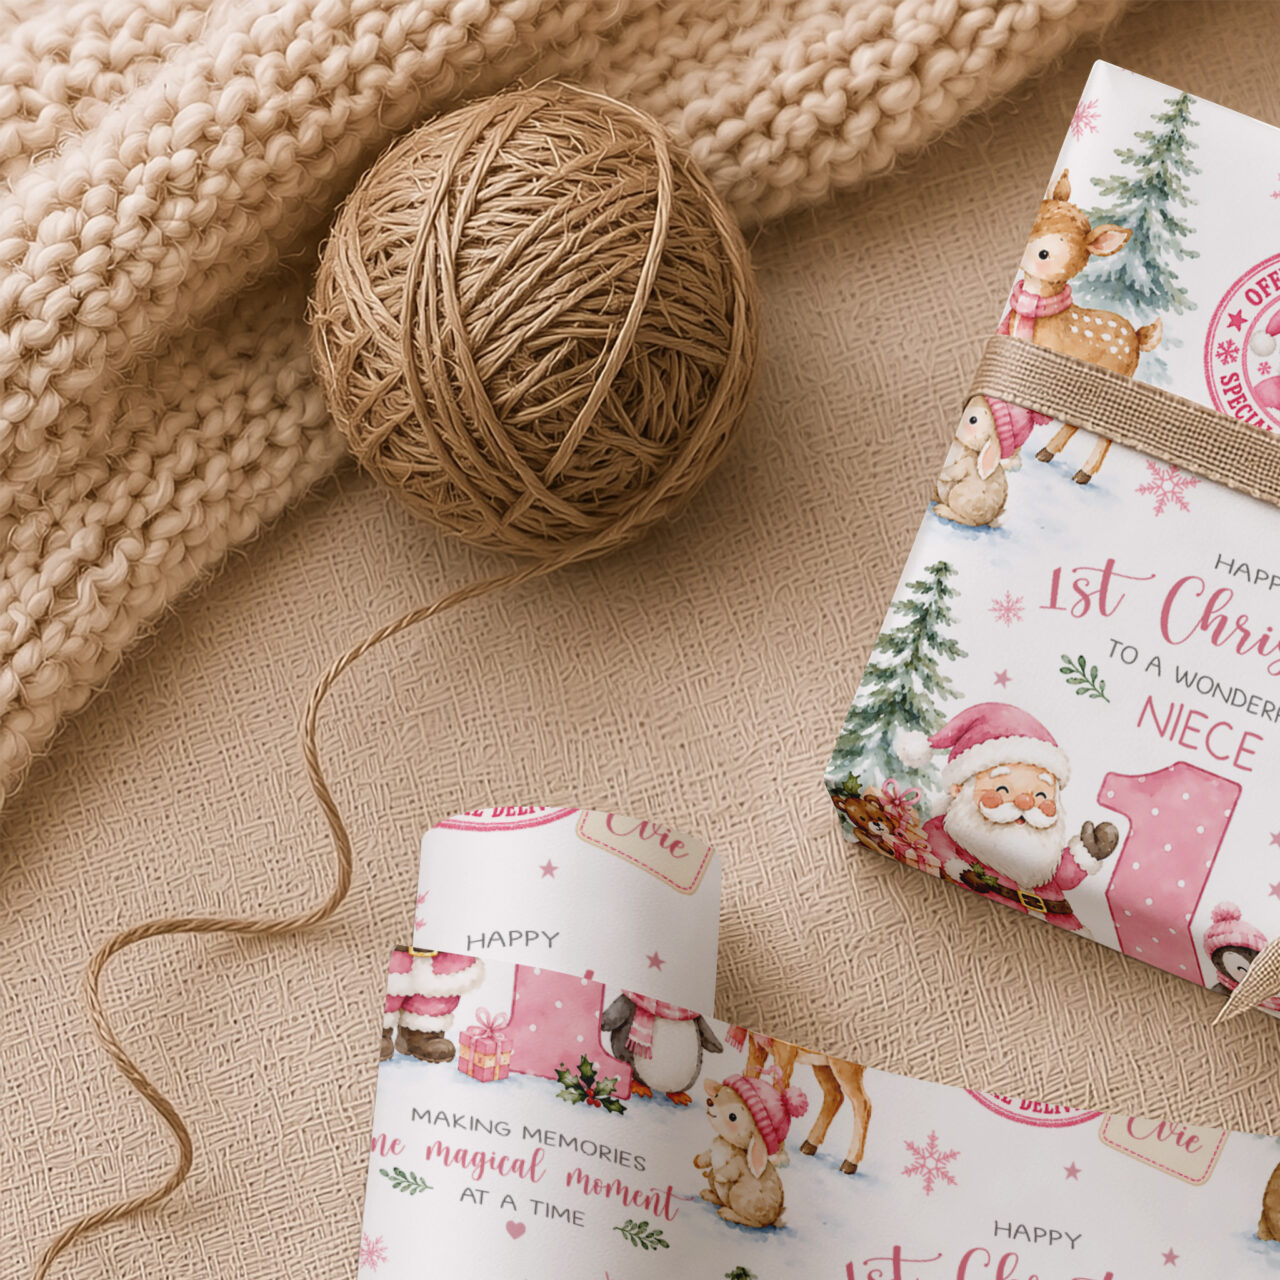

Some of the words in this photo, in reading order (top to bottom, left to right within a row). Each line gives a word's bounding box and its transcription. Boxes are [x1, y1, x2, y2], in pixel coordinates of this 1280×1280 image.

[1220, 372, 1273, 432] SPECI
[1039, 558, 1156, 618] 1st
[1108, 638, 1139, 665] TO
[1145, 656, 1162, 677] A
[1136, 695, 1264, 772] NIECE
[466, 930, 560, 951] HAPPY
[412, 1108, 512, 1137] MAKING
[522, 1126, 646, 1172] MEMORIES
[370, 1133, 406, 1158] ne
[425, 1140, 546, 1183] magical
[566, 1167, 695, 1222] moment
[460, 1187, 490, 1206] AT
[500, 1194, 518, 1211] A
[530, 1198, 586, 1228] TIME
[994, 1220, 1082, 1250] HAPPY
